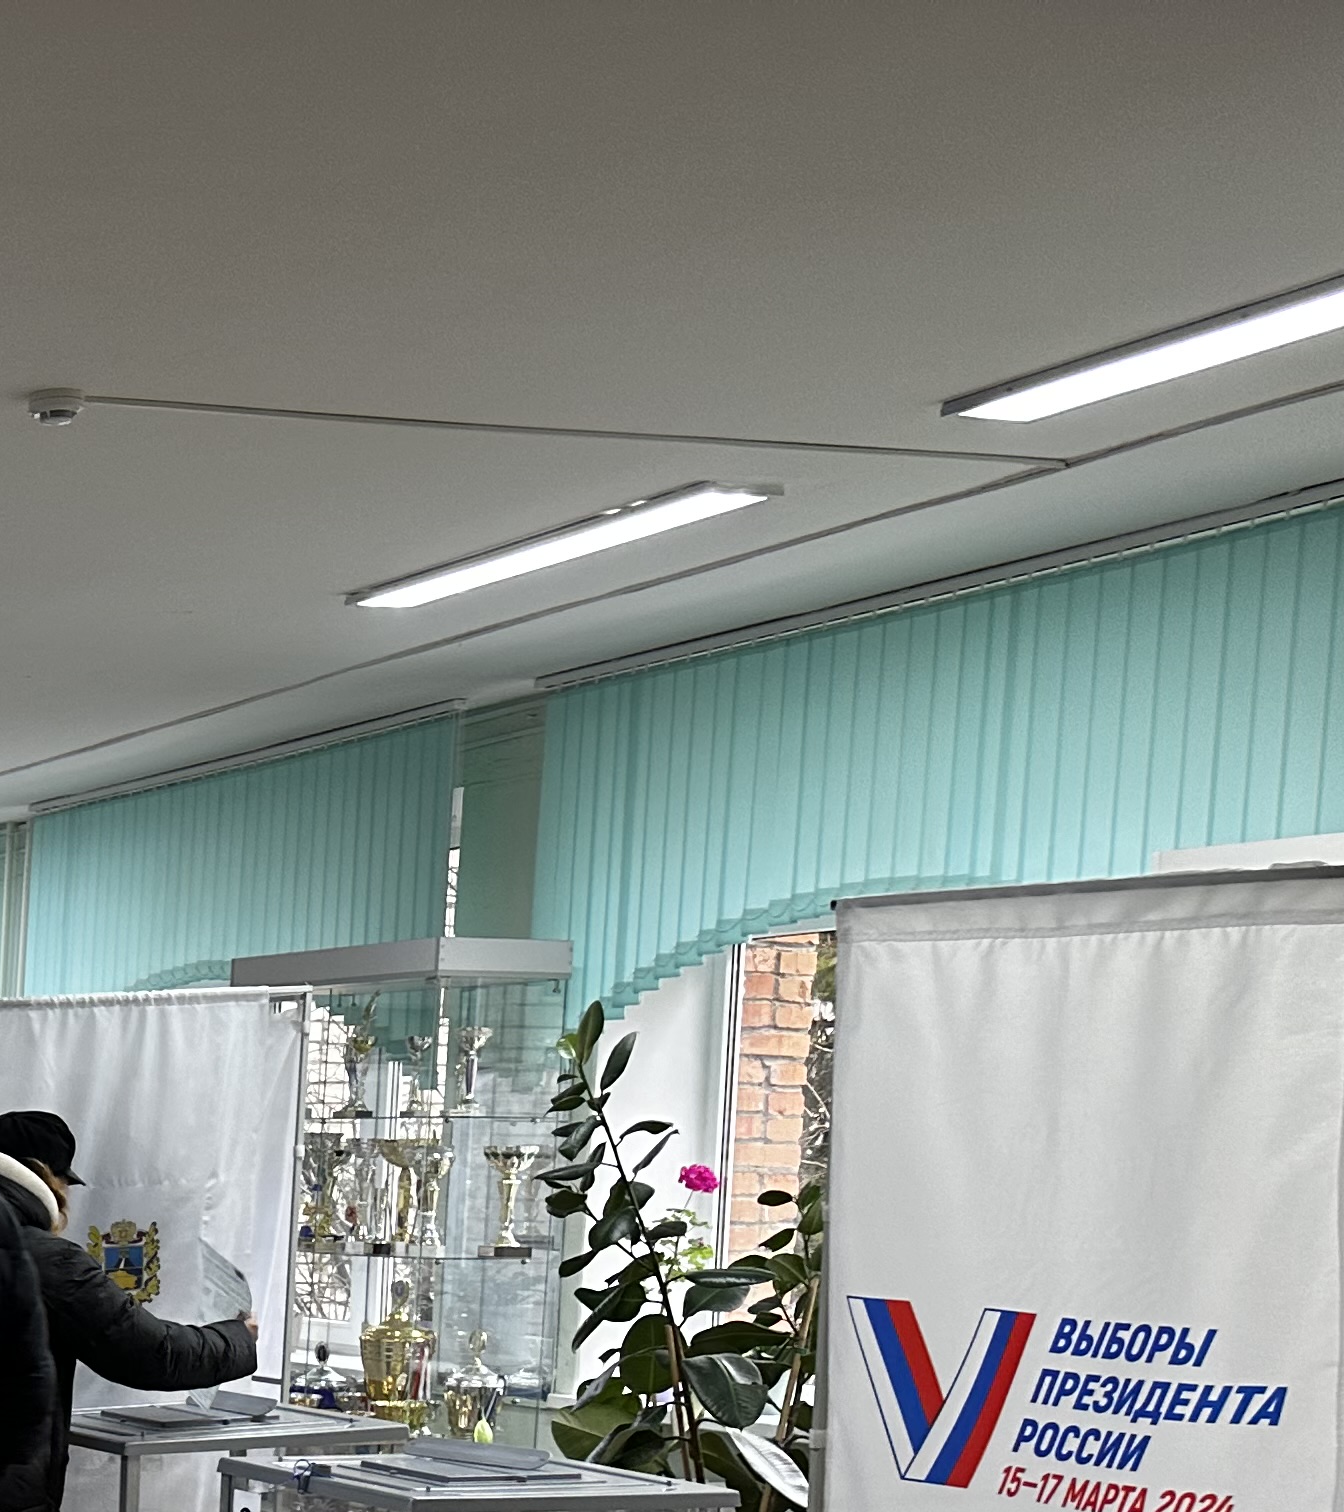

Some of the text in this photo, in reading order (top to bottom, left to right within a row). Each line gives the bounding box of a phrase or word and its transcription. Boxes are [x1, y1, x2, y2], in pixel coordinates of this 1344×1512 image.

[1049, 1317, 1218, 1368] ВЫБОРЫ
[1030, 1368, 1288, 1427] ПРЕЗИДЕНТА
[1012, 1418, 1151, 1472] РОССИИ
